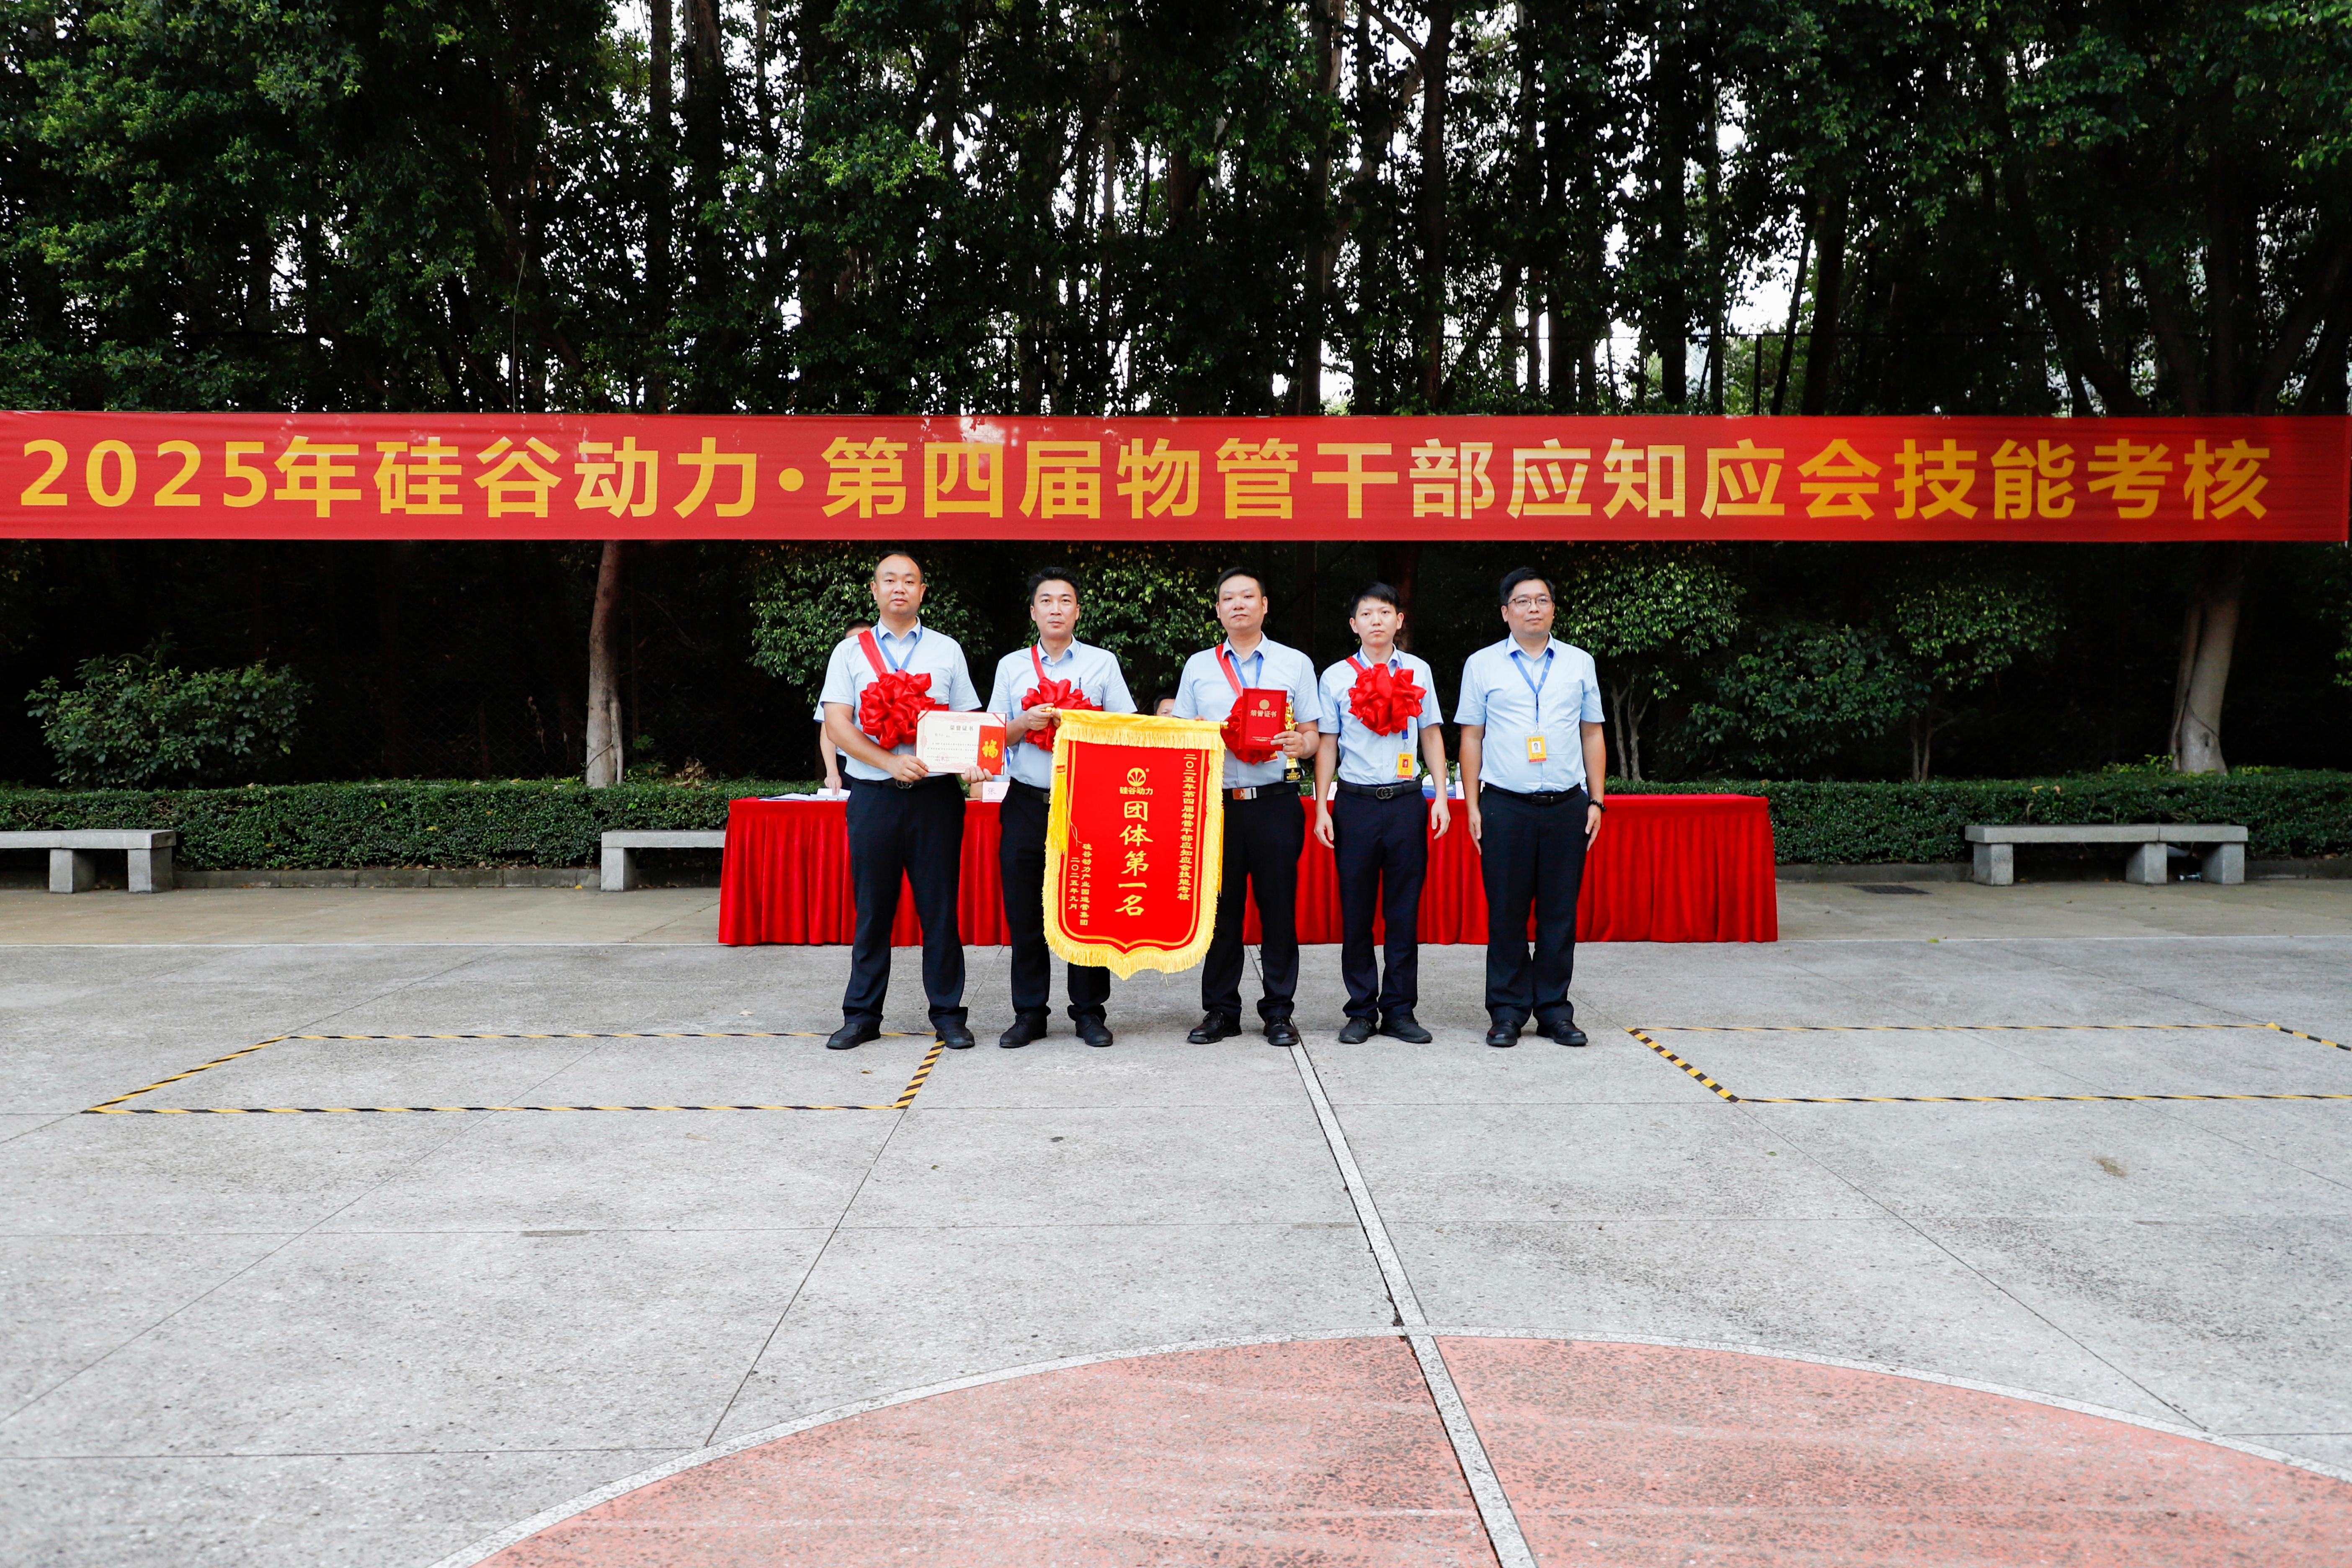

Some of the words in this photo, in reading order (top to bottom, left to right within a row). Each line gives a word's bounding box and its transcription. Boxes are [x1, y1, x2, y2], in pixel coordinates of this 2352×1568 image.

[21, 436, 2270, 520] 2025年硅谷动力·第四届物管干部应知应会技能考核
[1250, 709, 1277, 718] 荣誉证书
[982, 739, 998, 758] 福
[1119, 786, 1153, 795] 硅谷动力
[1115, 801, 1153, 916] 团体第一名
[1079, 843, 1092, 926] 硅谷动力产业园运营集团
